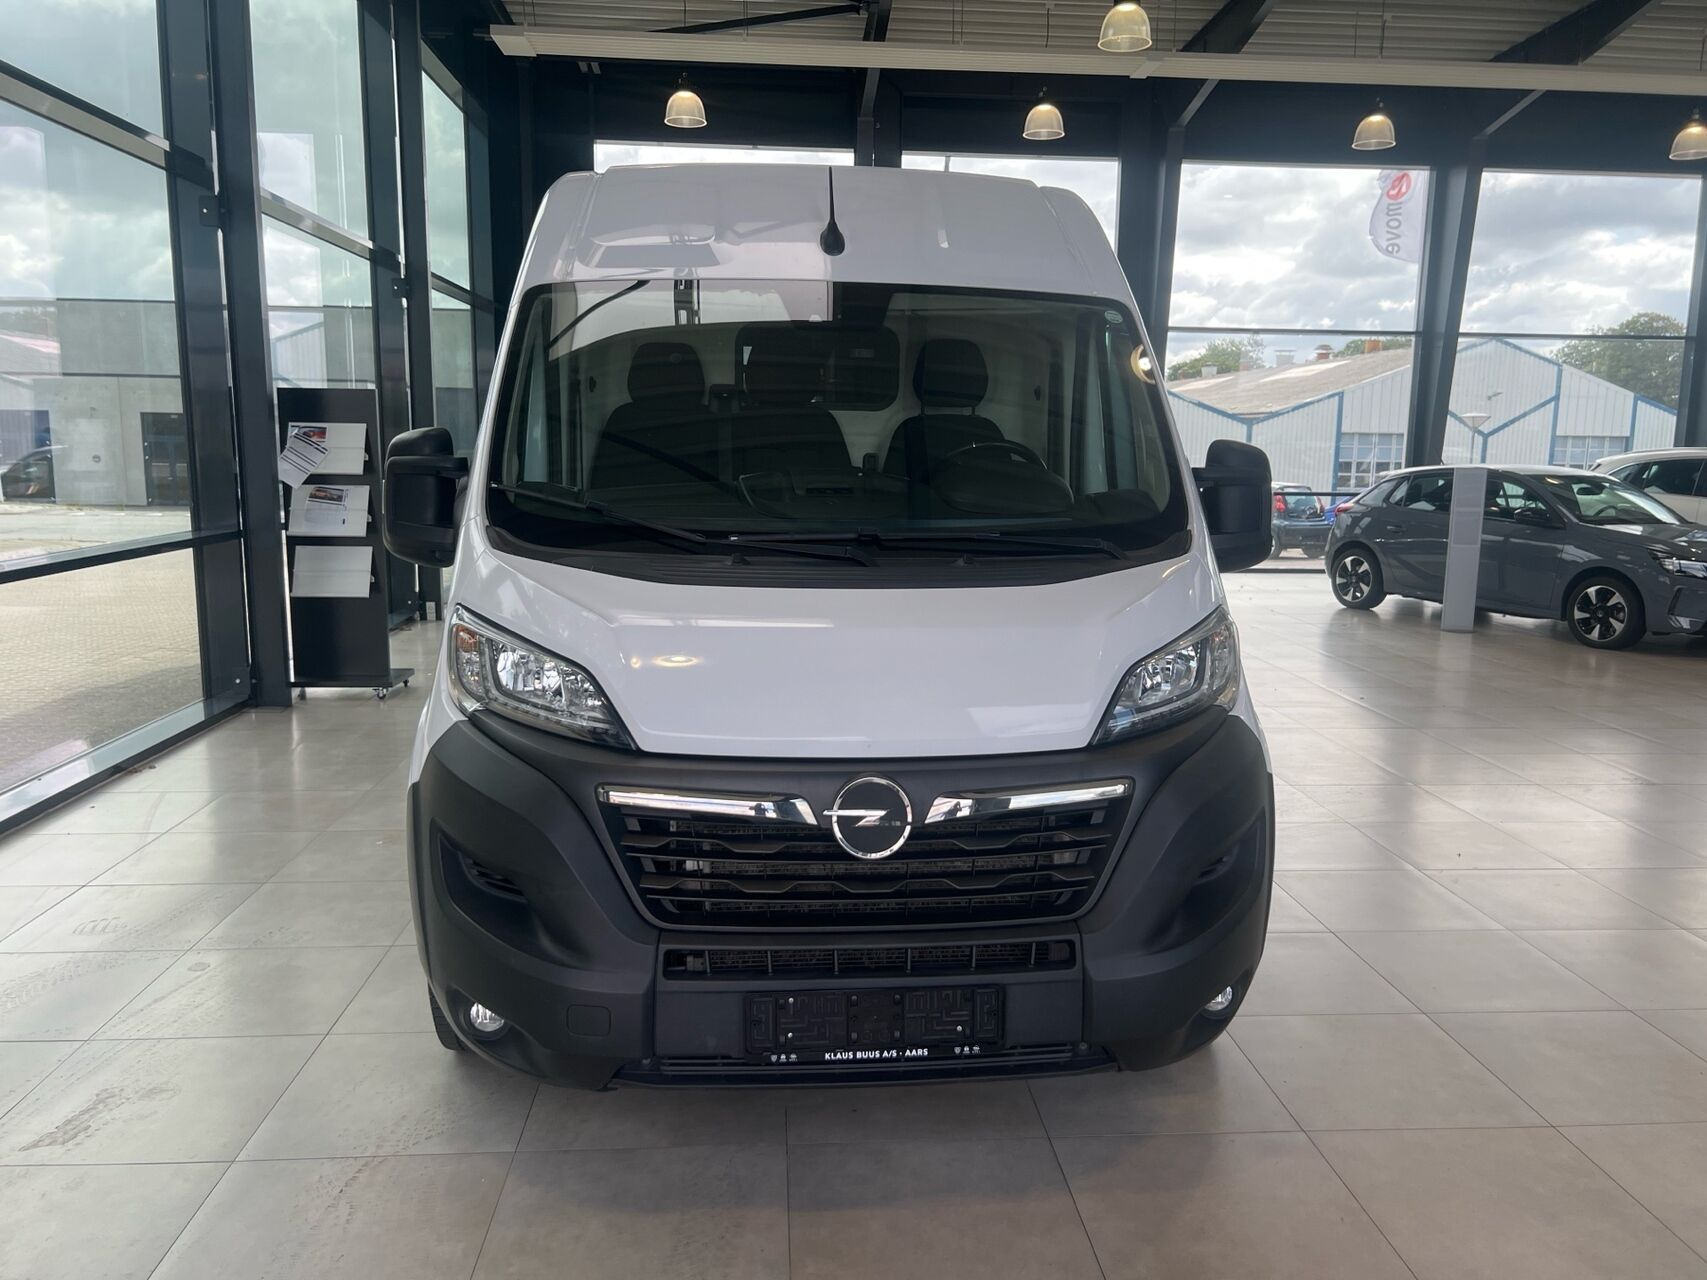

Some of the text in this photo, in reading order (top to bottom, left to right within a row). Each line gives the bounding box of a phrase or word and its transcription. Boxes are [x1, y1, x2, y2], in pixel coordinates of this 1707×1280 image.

[824, 1048, 929, 1060] KLAUS BUUS A/S AARS
